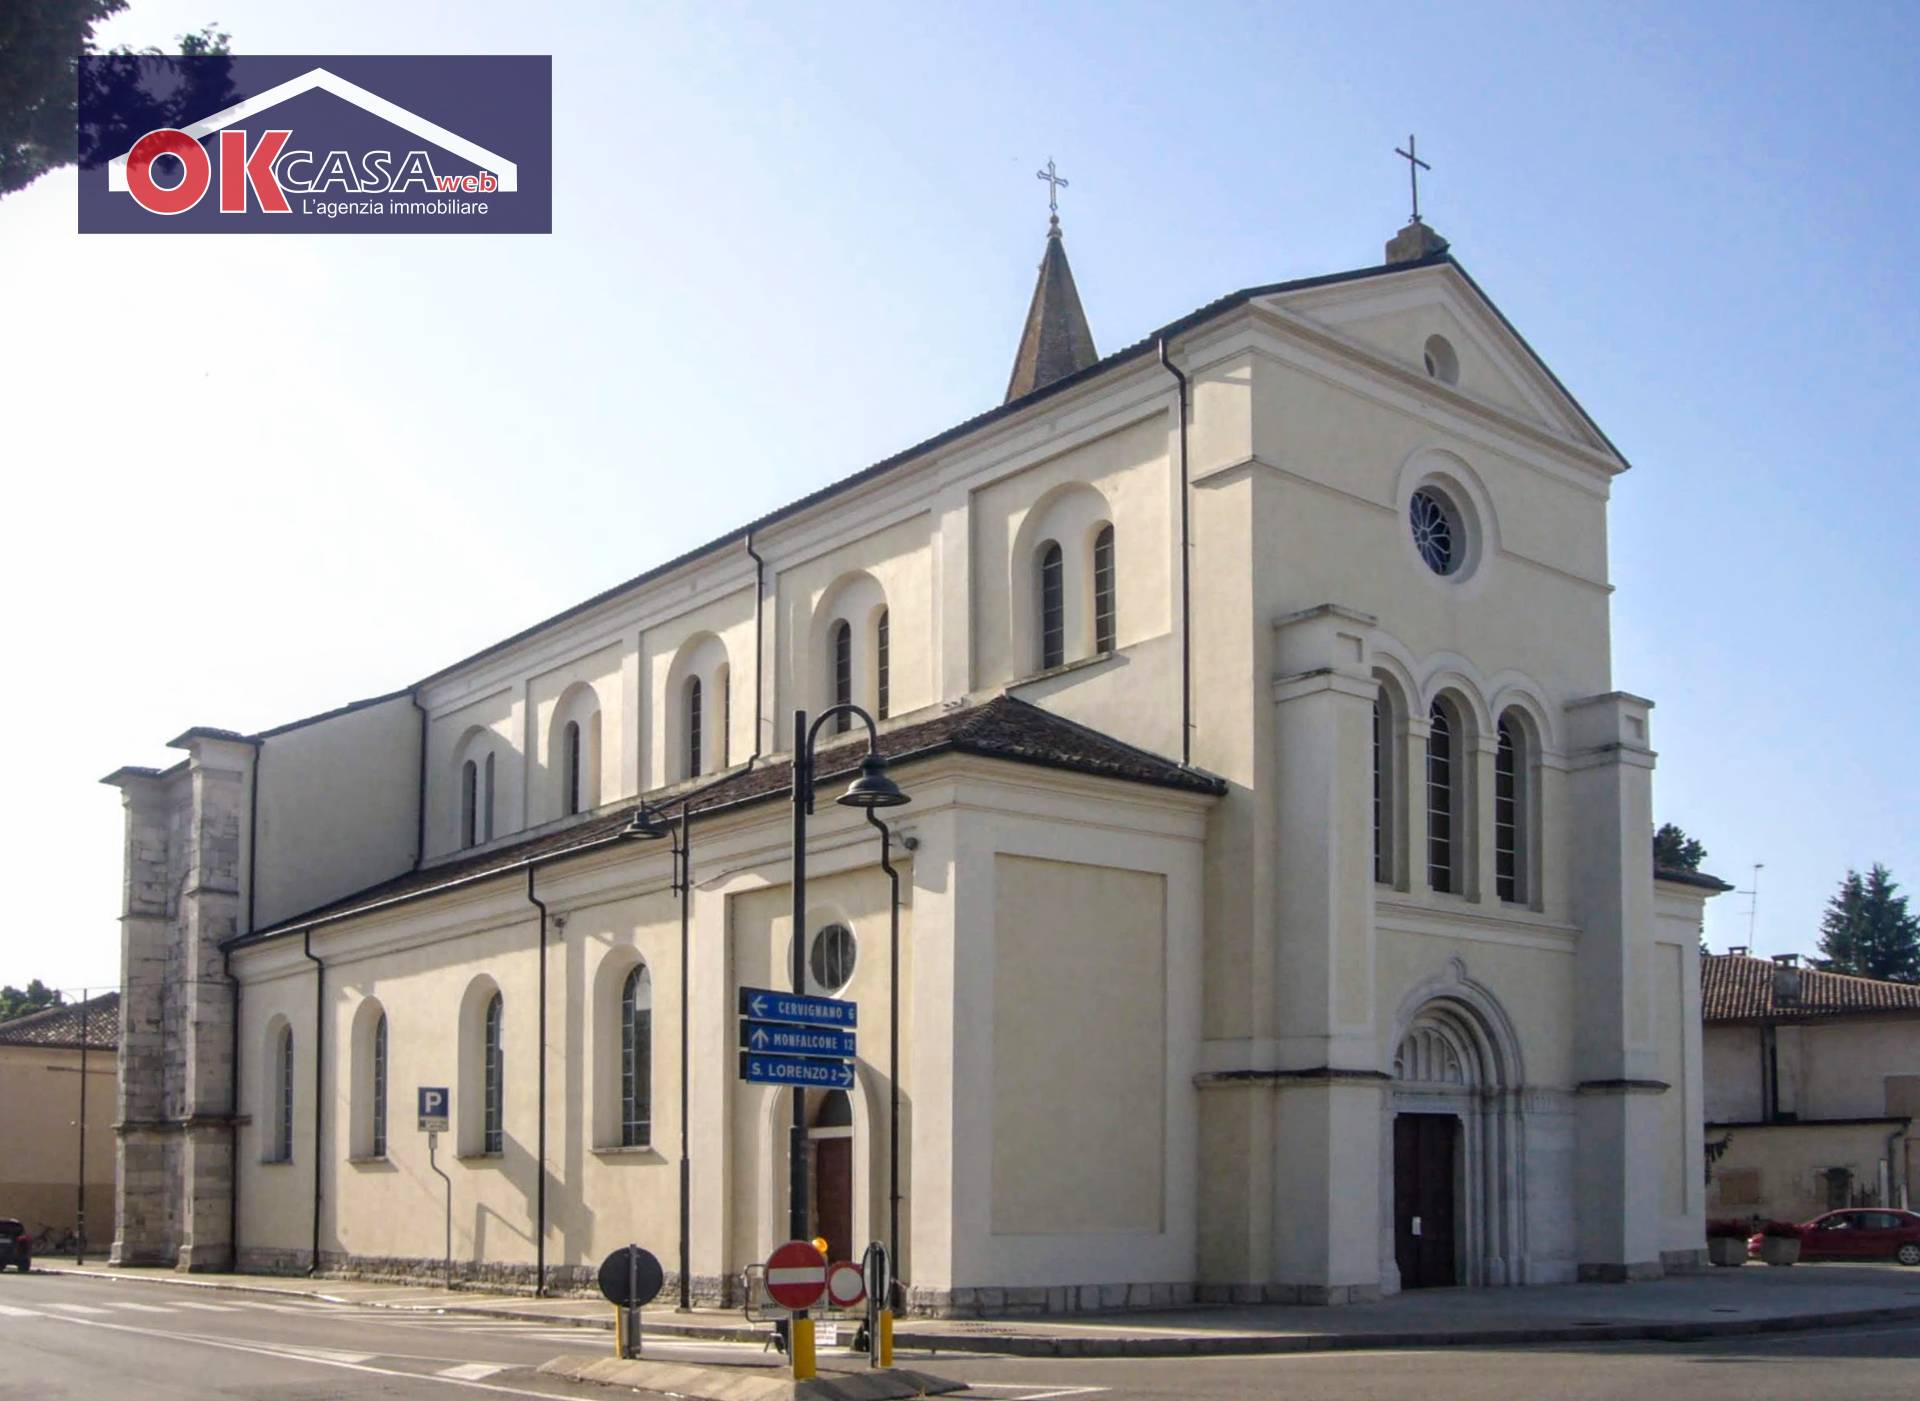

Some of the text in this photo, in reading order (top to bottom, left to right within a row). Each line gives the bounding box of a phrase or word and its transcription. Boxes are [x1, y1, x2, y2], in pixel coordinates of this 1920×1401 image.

[778, 1001, 843, 1019] CERVIGNANO
[773, 1033, 854, 1051] MONFALCONE 12
[768, 1064, 828, 1080] LORENZO
[831, 1069, 837, 1081] 2
[425, 1091, 442, 1113] P
